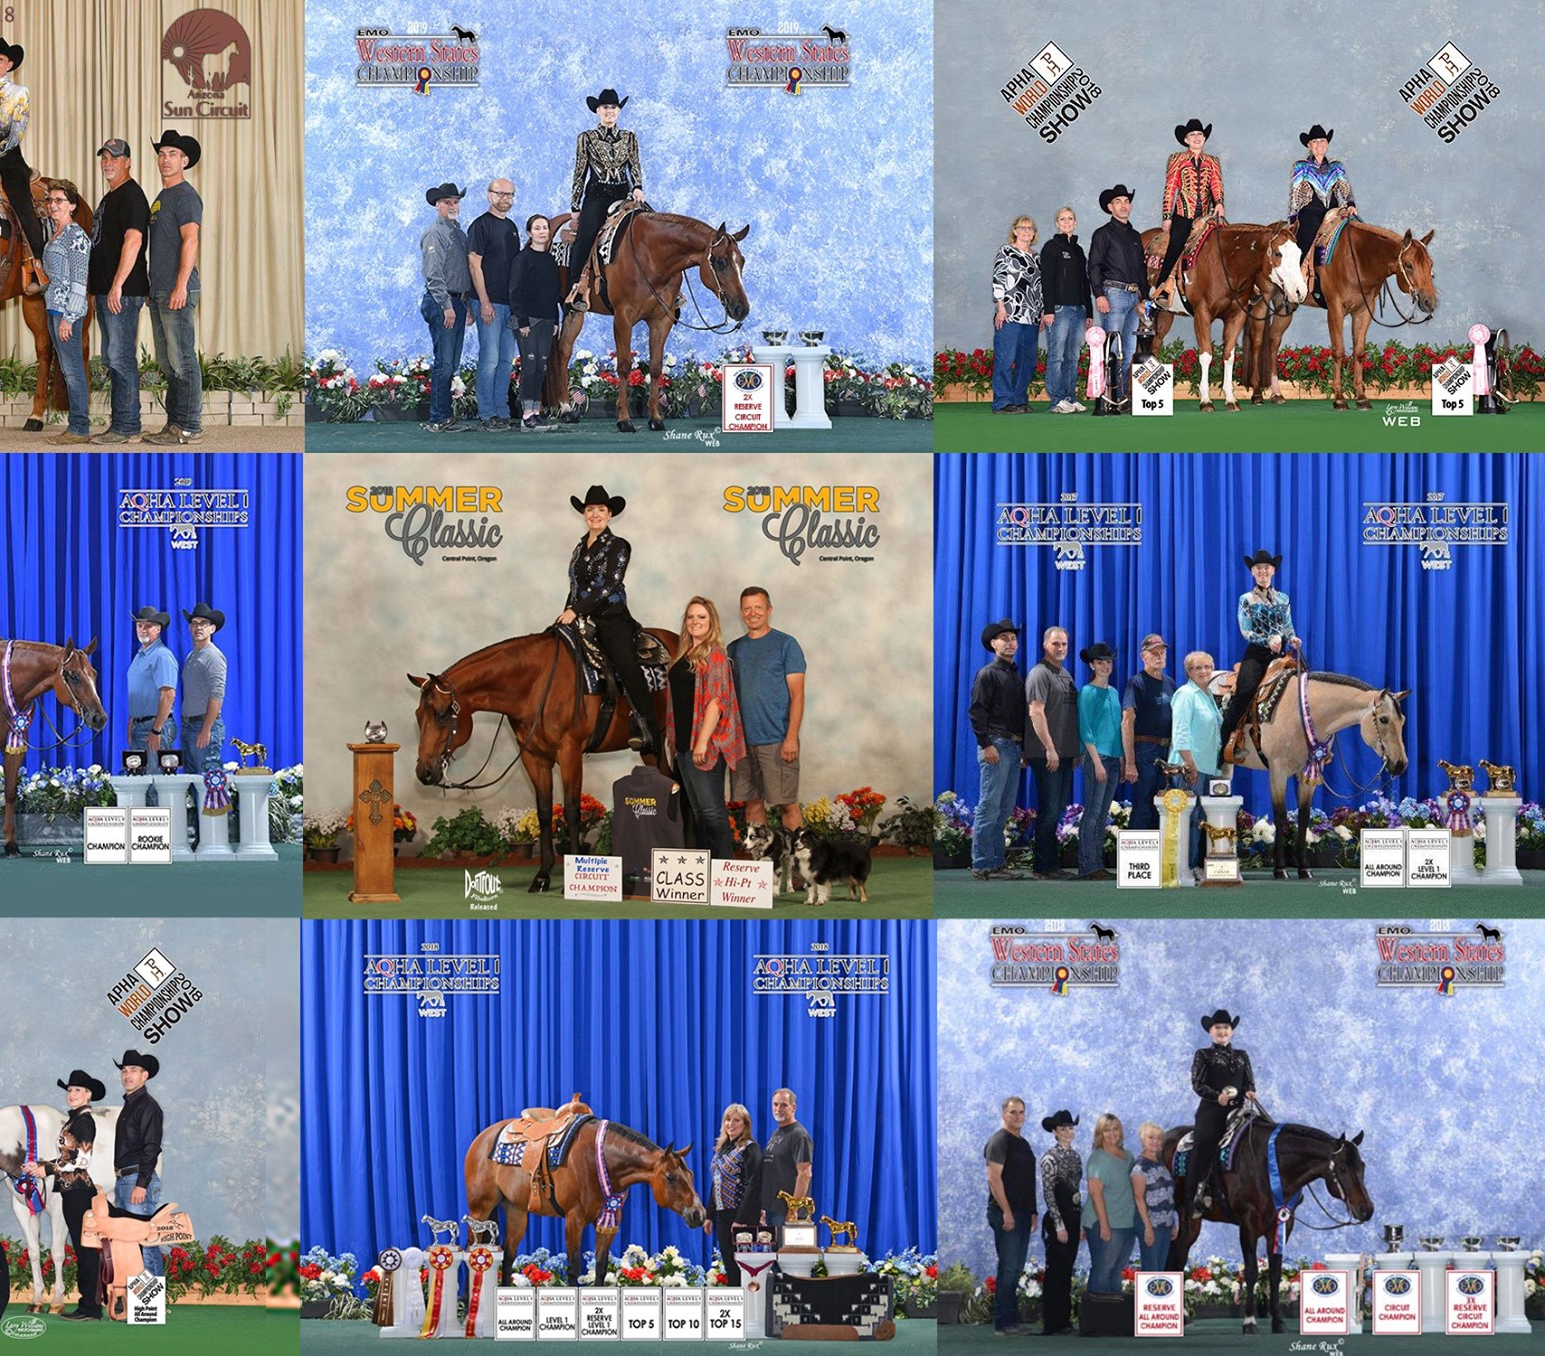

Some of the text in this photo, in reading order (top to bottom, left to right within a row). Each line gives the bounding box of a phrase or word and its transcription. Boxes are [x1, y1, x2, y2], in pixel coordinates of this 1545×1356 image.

[357, 28, 389, 36] EMO
[357, 39, 479, 63] Western States
[999, 67, 1035, 103] APHA
[1071, 67, 1102, 99] 2018
[1011, 79, 1049, 116] WORLD
[1024, 72, 1078, 130] CHAMPIONSHIP
[1038, 88, 1093, 144] SHOW
[1141, 399, 1164, 411] Top 5
[369, 486, 393, 496] 2018
[345, 486, 503, 513] SUMMER
[996, 507, 1132, 528] AQHA LEVEL
[384, 502, 504, 566] Classic
[996, 527, 1142, 541] CHAMPIONSHIPS
[138, 835, 163, 843] ROOKIE
[575, 856, 607, 865] Multiple
[576, 865, 610, 873] Reserve
[723, 861, 760, 873] Reserve
[1129, 863, 1150, 871] THIRD
[574, 872, 609, 881] CIRCUIT
[656, 871, 705, 886] CLASS
[1128, 871, 1152, 879] PLACE
[724, 876, 752, 888] Hi-Pt
[569, 884, 618, 893] CHAMPION
[656, 888, 705, 900] Winner
[722, 892, 756, 904] Winner
[992, 926, 1025, 934] EMO
[991, 937, 1119, 963] Western States
[364, 958, 489, 977] AQHA LEVEL
[364, 977, 500, 990] CHAMPIONSHIPS
[161, 1232, 192, 1242] HIGH POINT
[720, 1309, 730, 1318] 2X
[628, 1319, 654, 1329] TOP 5
[668, 1319, 699, 1329] TOP 10
[710, 1319, 742, 1328] TOP 15
